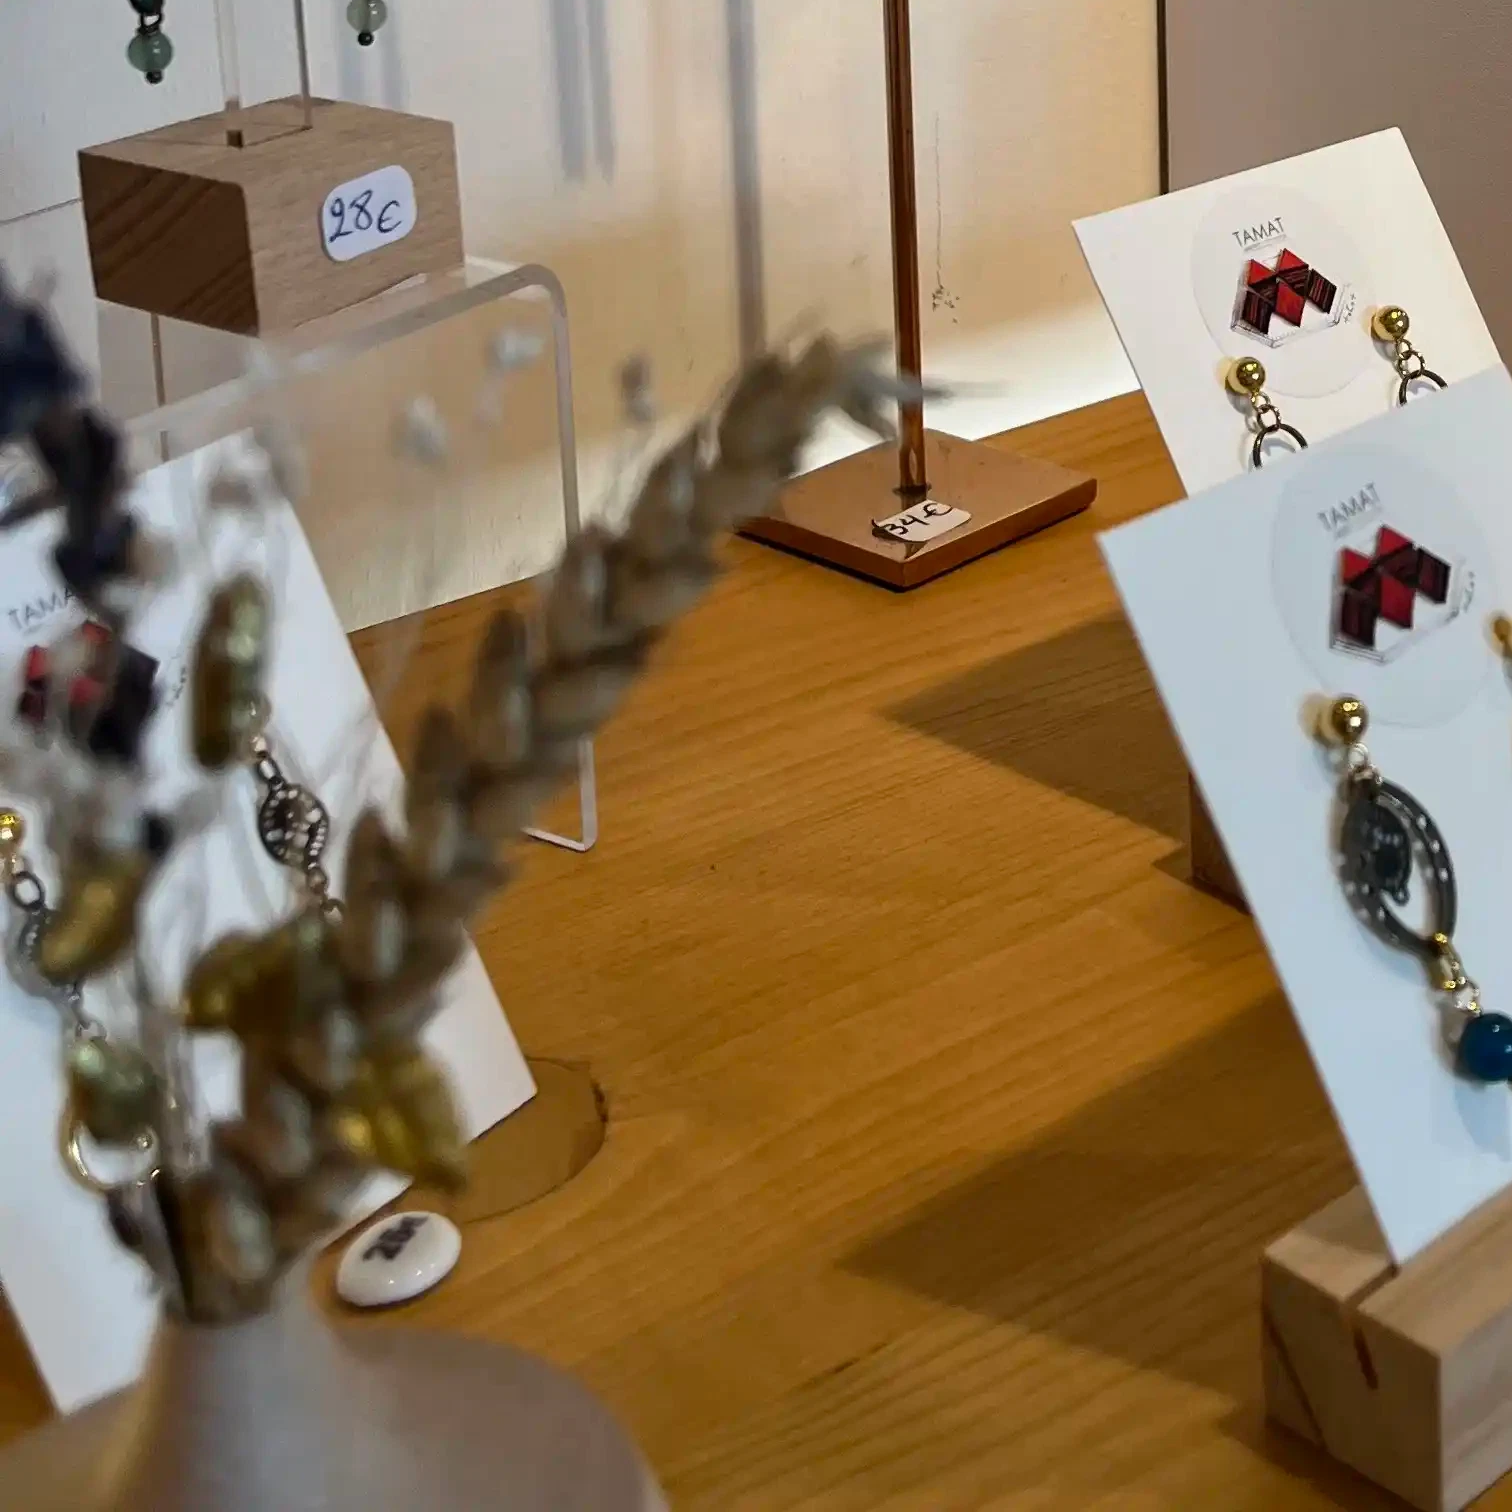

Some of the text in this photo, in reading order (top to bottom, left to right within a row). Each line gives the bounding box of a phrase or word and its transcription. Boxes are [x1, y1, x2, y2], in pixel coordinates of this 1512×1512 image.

[329, 189, 402, 243] 28€
[1232, 217, 1284, 247] TAMAT
[1317, 482, 1381, 532] TAMAT
[8, 589, 74, 631] TAMA
